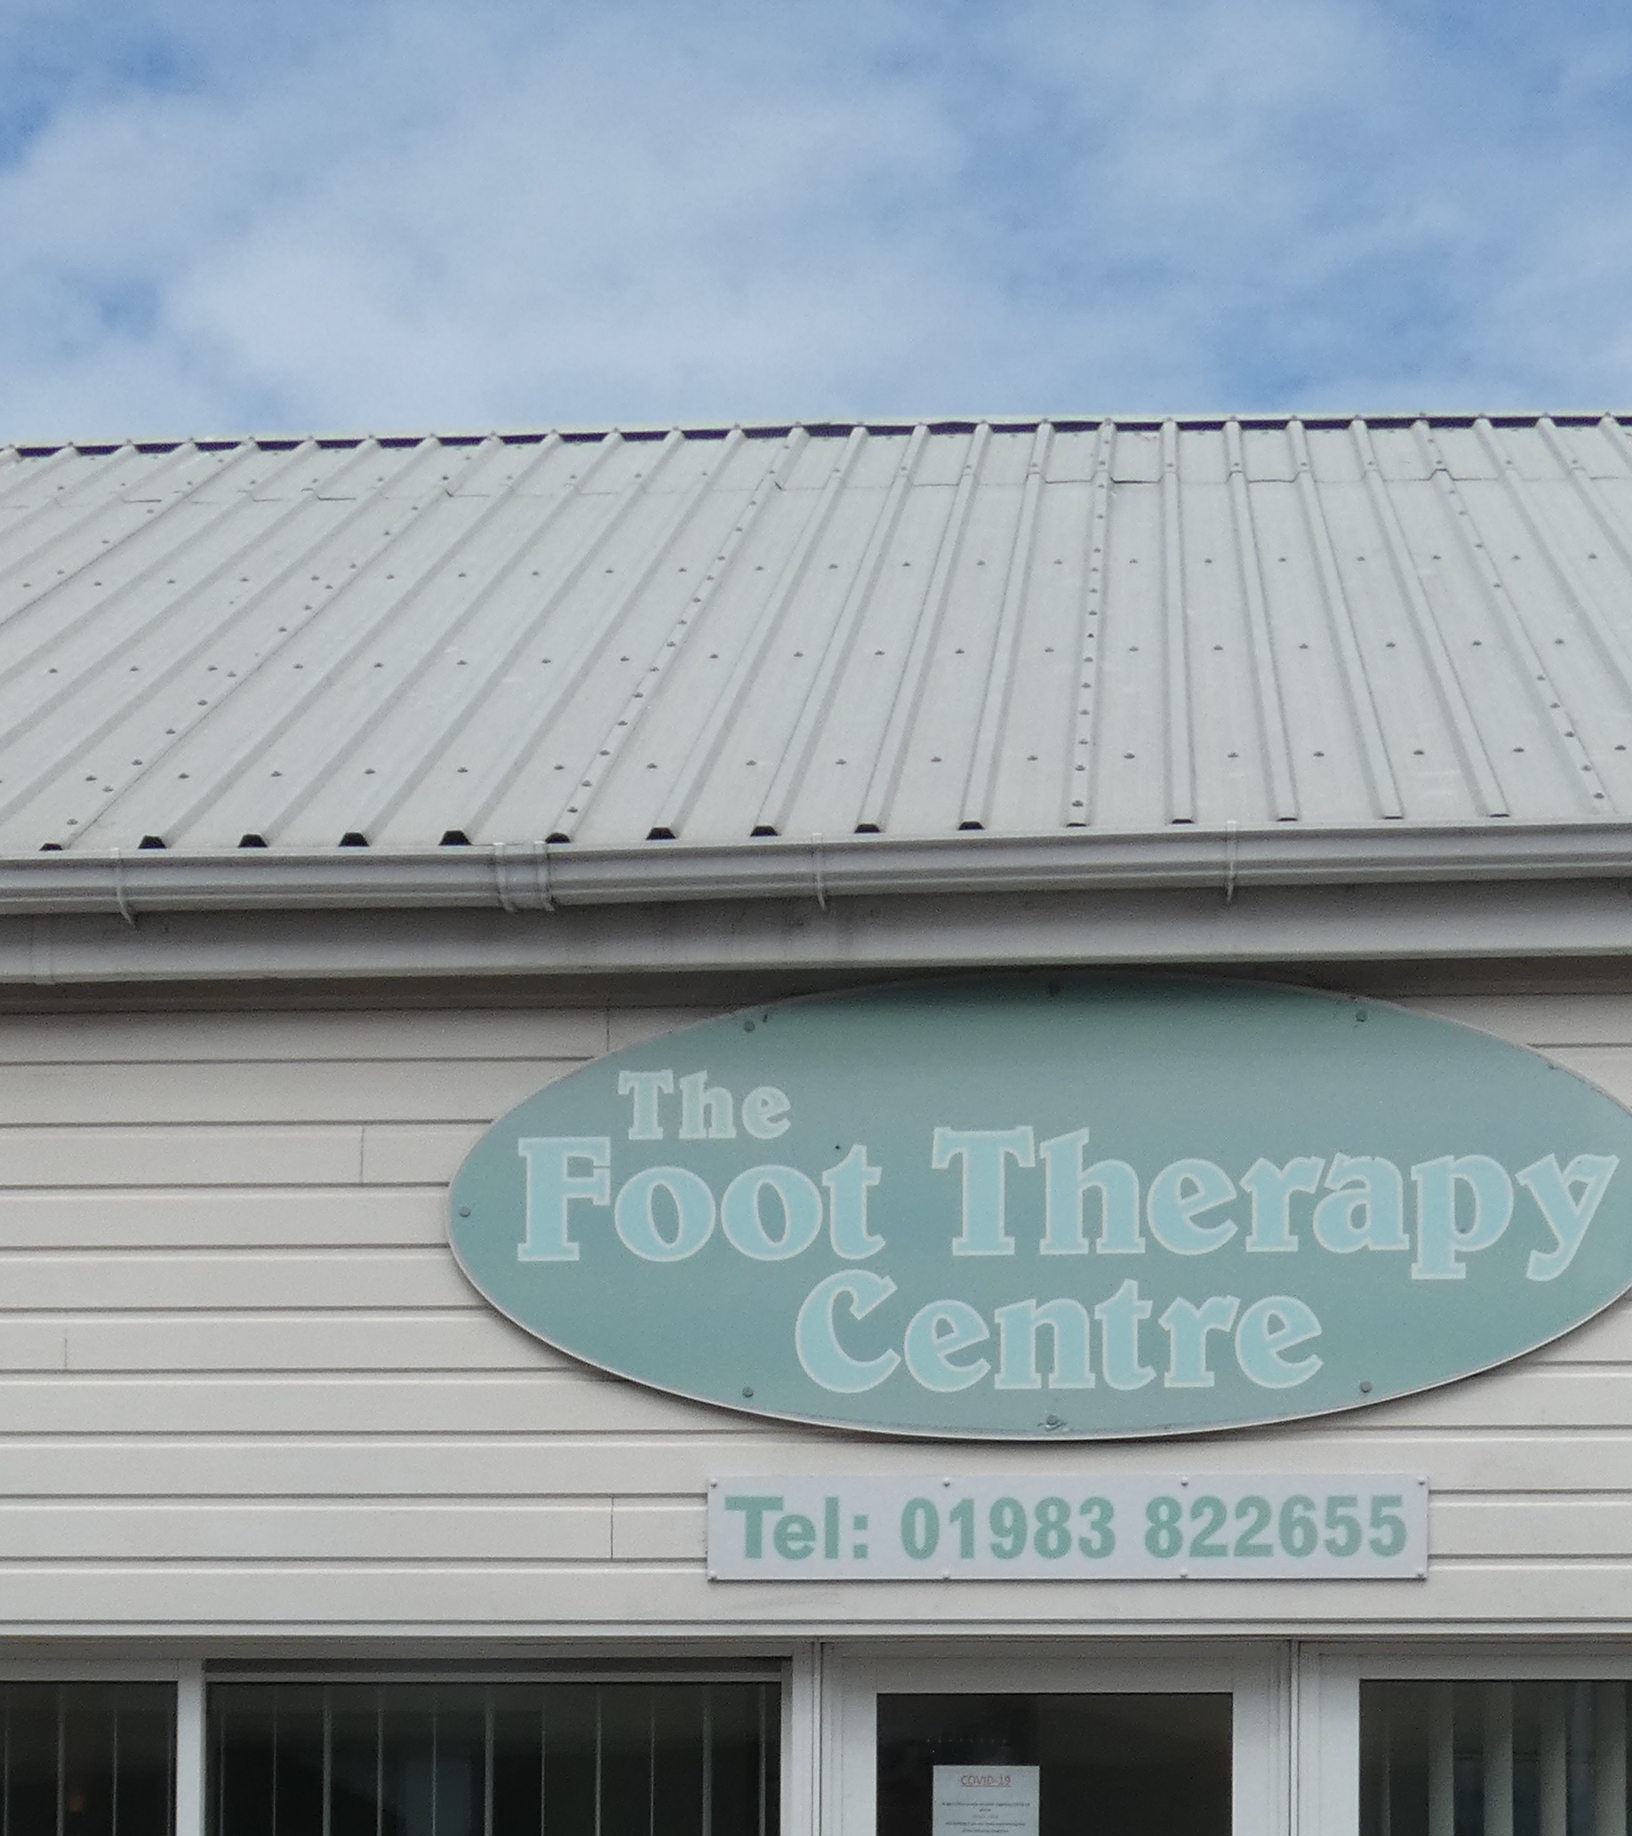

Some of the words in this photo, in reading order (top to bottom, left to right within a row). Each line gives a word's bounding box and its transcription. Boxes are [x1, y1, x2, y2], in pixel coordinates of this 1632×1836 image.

[618, 1067, 792, 1141] The
[516, 1135, 884, 1262] Foot
[930, 1125, 1620, 1281] Therapy
[795, 1269, 1324, 1394] Centre
[725, 1494, 870, 1562] Tel:
[899, 1494, 1118, 1562] 01983
[1143, 1493, 1409, 1561] 822655
[960, 1774, 1011, 1788] COVID-19
